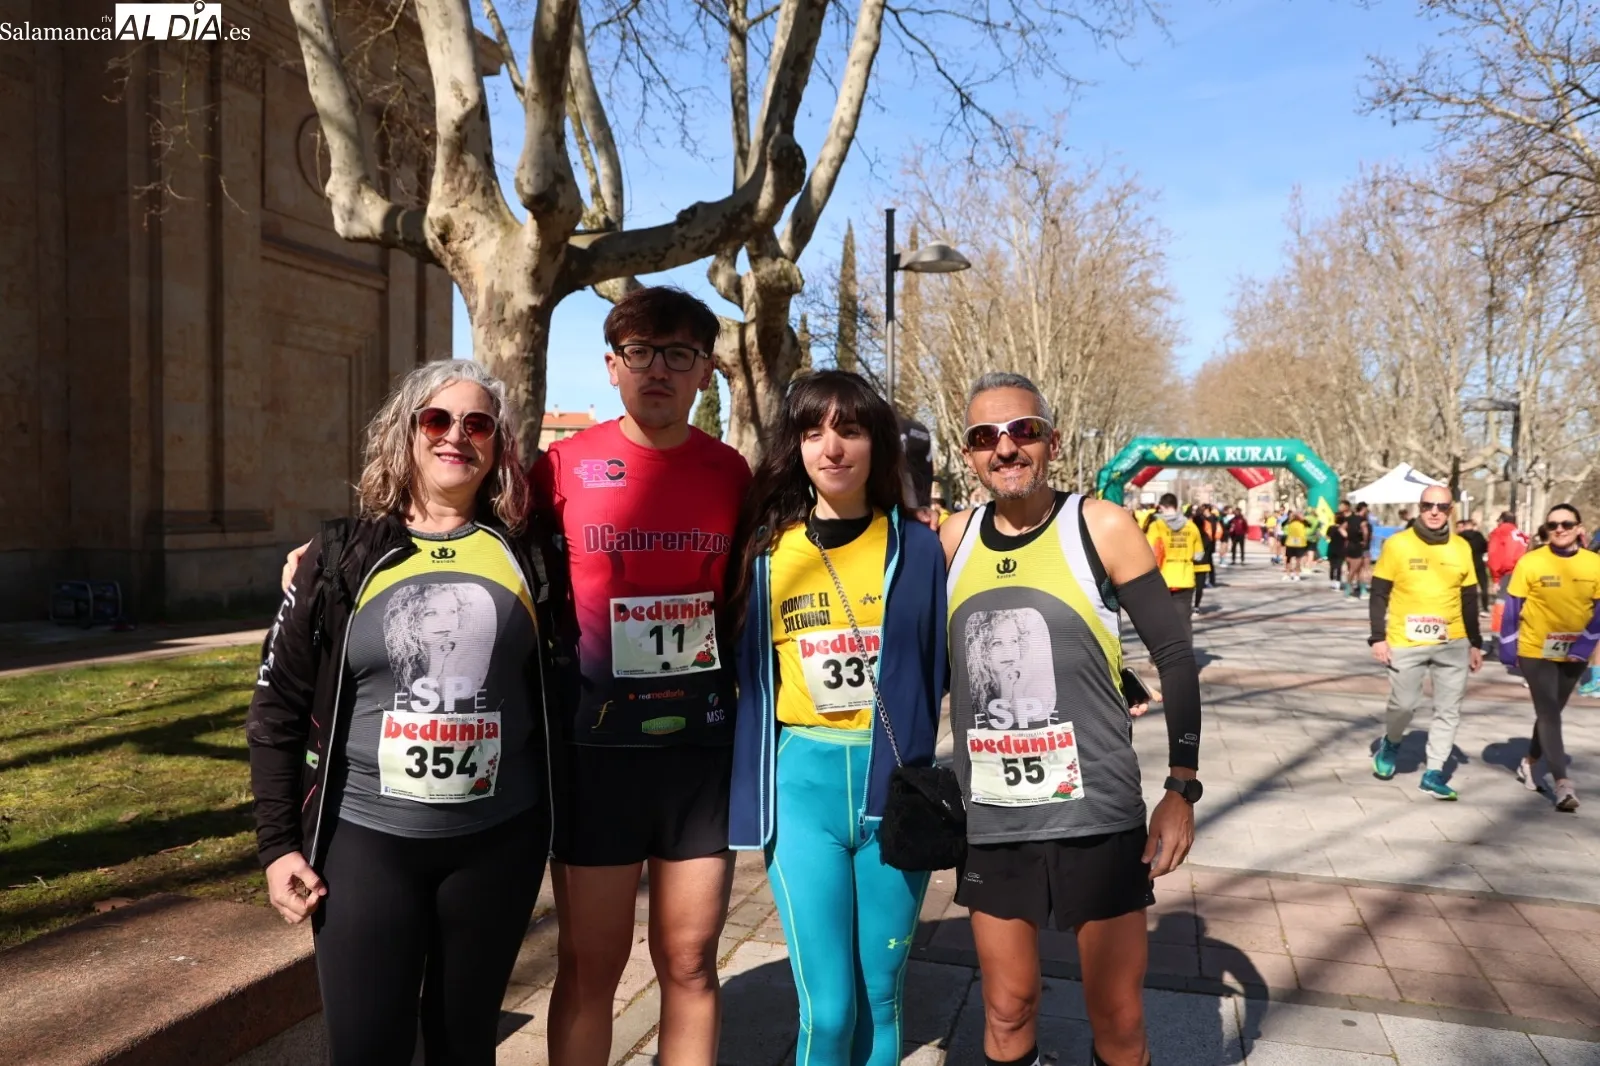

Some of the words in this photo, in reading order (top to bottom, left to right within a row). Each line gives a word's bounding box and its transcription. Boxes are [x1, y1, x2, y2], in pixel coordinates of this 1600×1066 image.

[1175, 446, 1221, 464] CAJA
[1225, 446, 1287, 462] RURAL
[583, 523, 731, 554] DCabrerizos
[613, 598, 713, 622] bedunia
[818, 592, 830, 607] EL
[784, 609, 831, 634] SILENCIO!
[1415, 624, 1440, 634] 409
[649, 623, 685, 656] 11
[800, 633, 880, 659] bedun
[822, 656, 878, 690] 33
[393, 677, 487, 713] ESPE
[706, 709, 725, 723] MSC
[974, 699, 1059, 730] ESPE
[384, 718, 499, 741] bedunia
[405, 746, 477, 779] 354
[1002, 756, 1045, 786] 55
